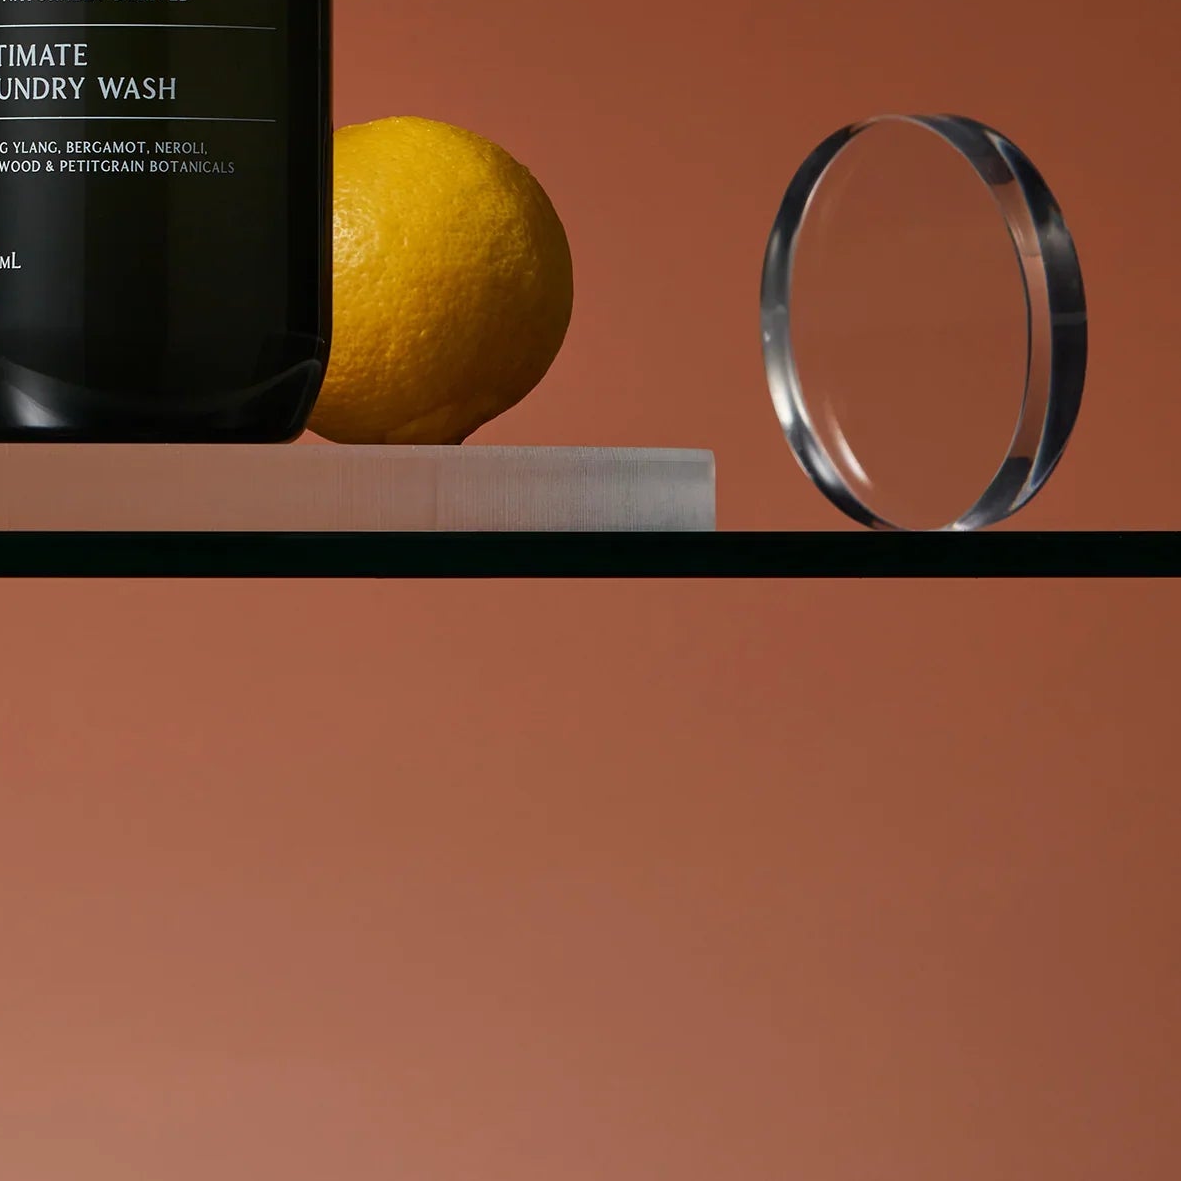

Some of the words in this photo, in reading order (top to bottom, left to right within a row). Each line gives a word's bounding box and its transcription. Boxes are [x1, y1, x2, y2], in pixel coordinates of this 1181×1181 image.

[97, 76, 177, 101] WASH
[12, 140, 62, 155] YLANG,
[65, 140, 151, 156] BERGAMOT,
[154, 141, 209, 157] NEROLI,
[45, 159, 55, 173] &
[59, 159, 145, 173] PETITGRAIN
[148, 159, 235, 175] BOTANICALS
